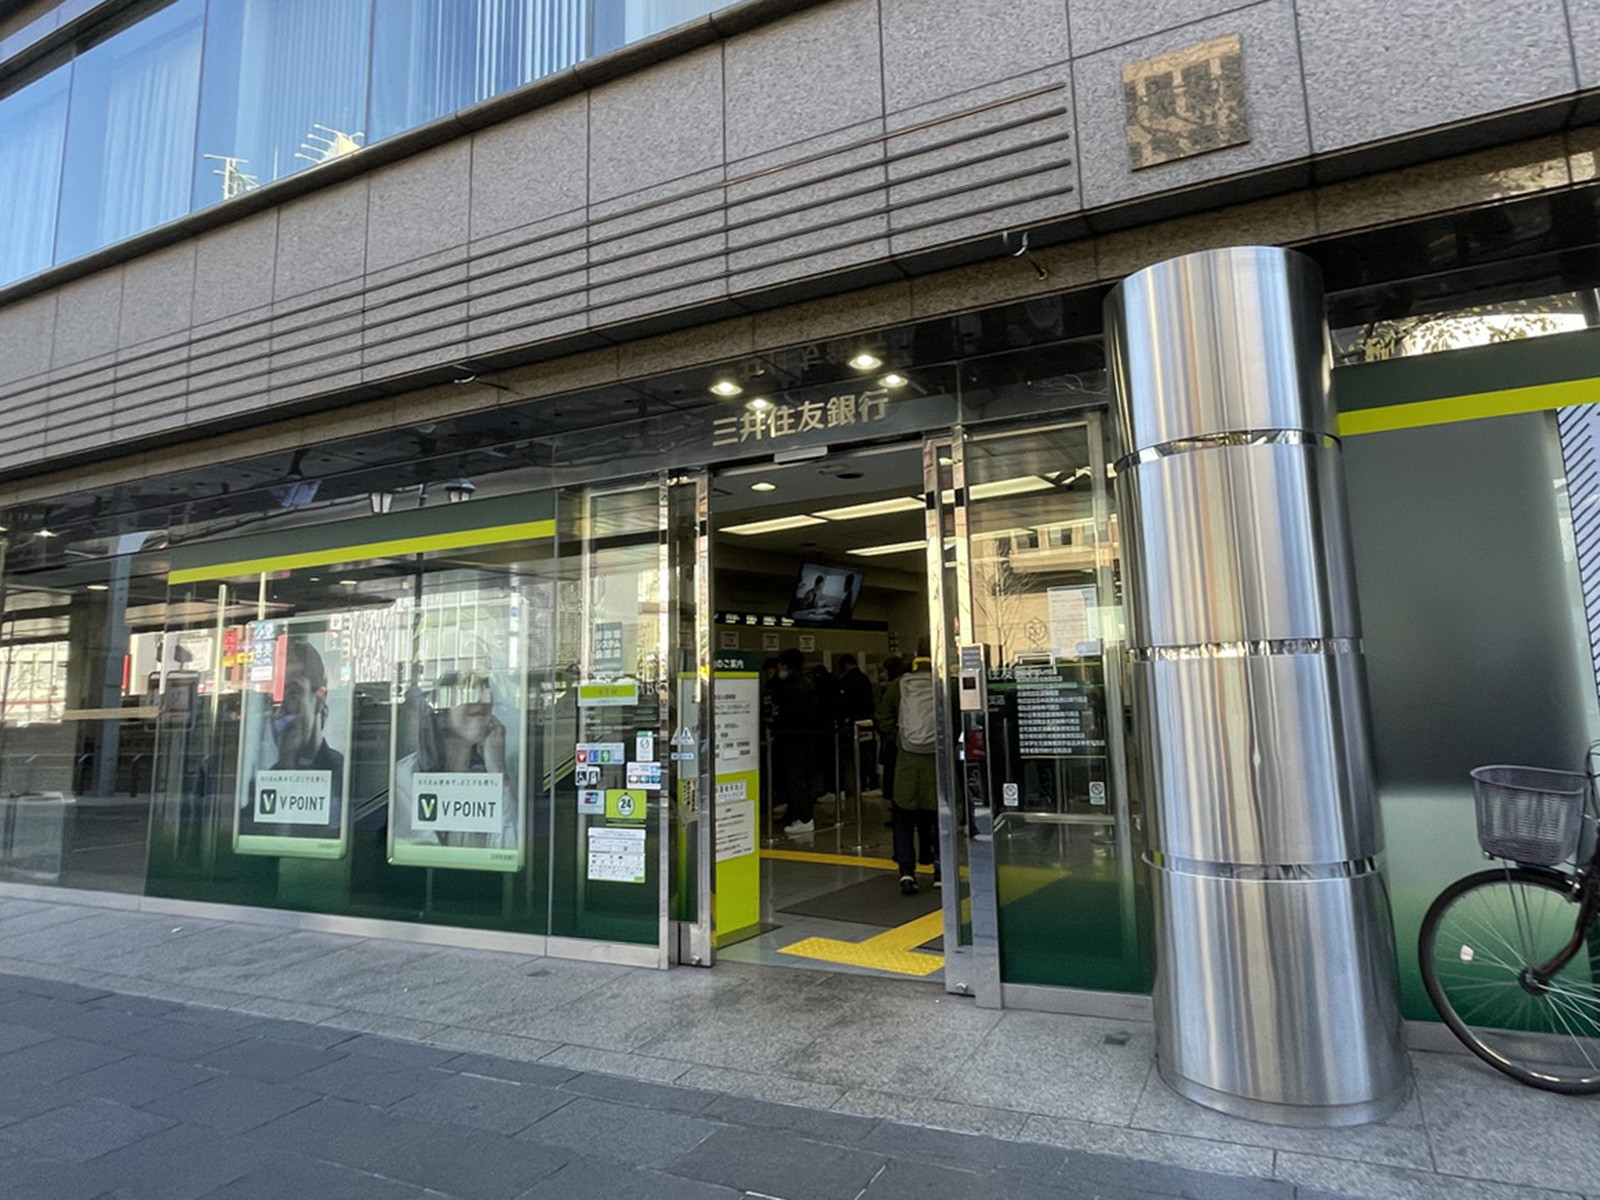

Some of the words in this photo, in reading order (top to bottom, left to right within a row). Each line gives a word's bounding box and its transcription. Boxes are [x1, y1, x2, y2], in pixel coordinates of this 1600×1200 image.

[712, 388, 888, 446] 三井住友銀行
[280, 796, 288, 809] V
[289, 796, 326, 811] POINT
[442, 801, 451, 816] V
[453, 801, 497, 818] POINT
[620, 798, 632, 809] 24
